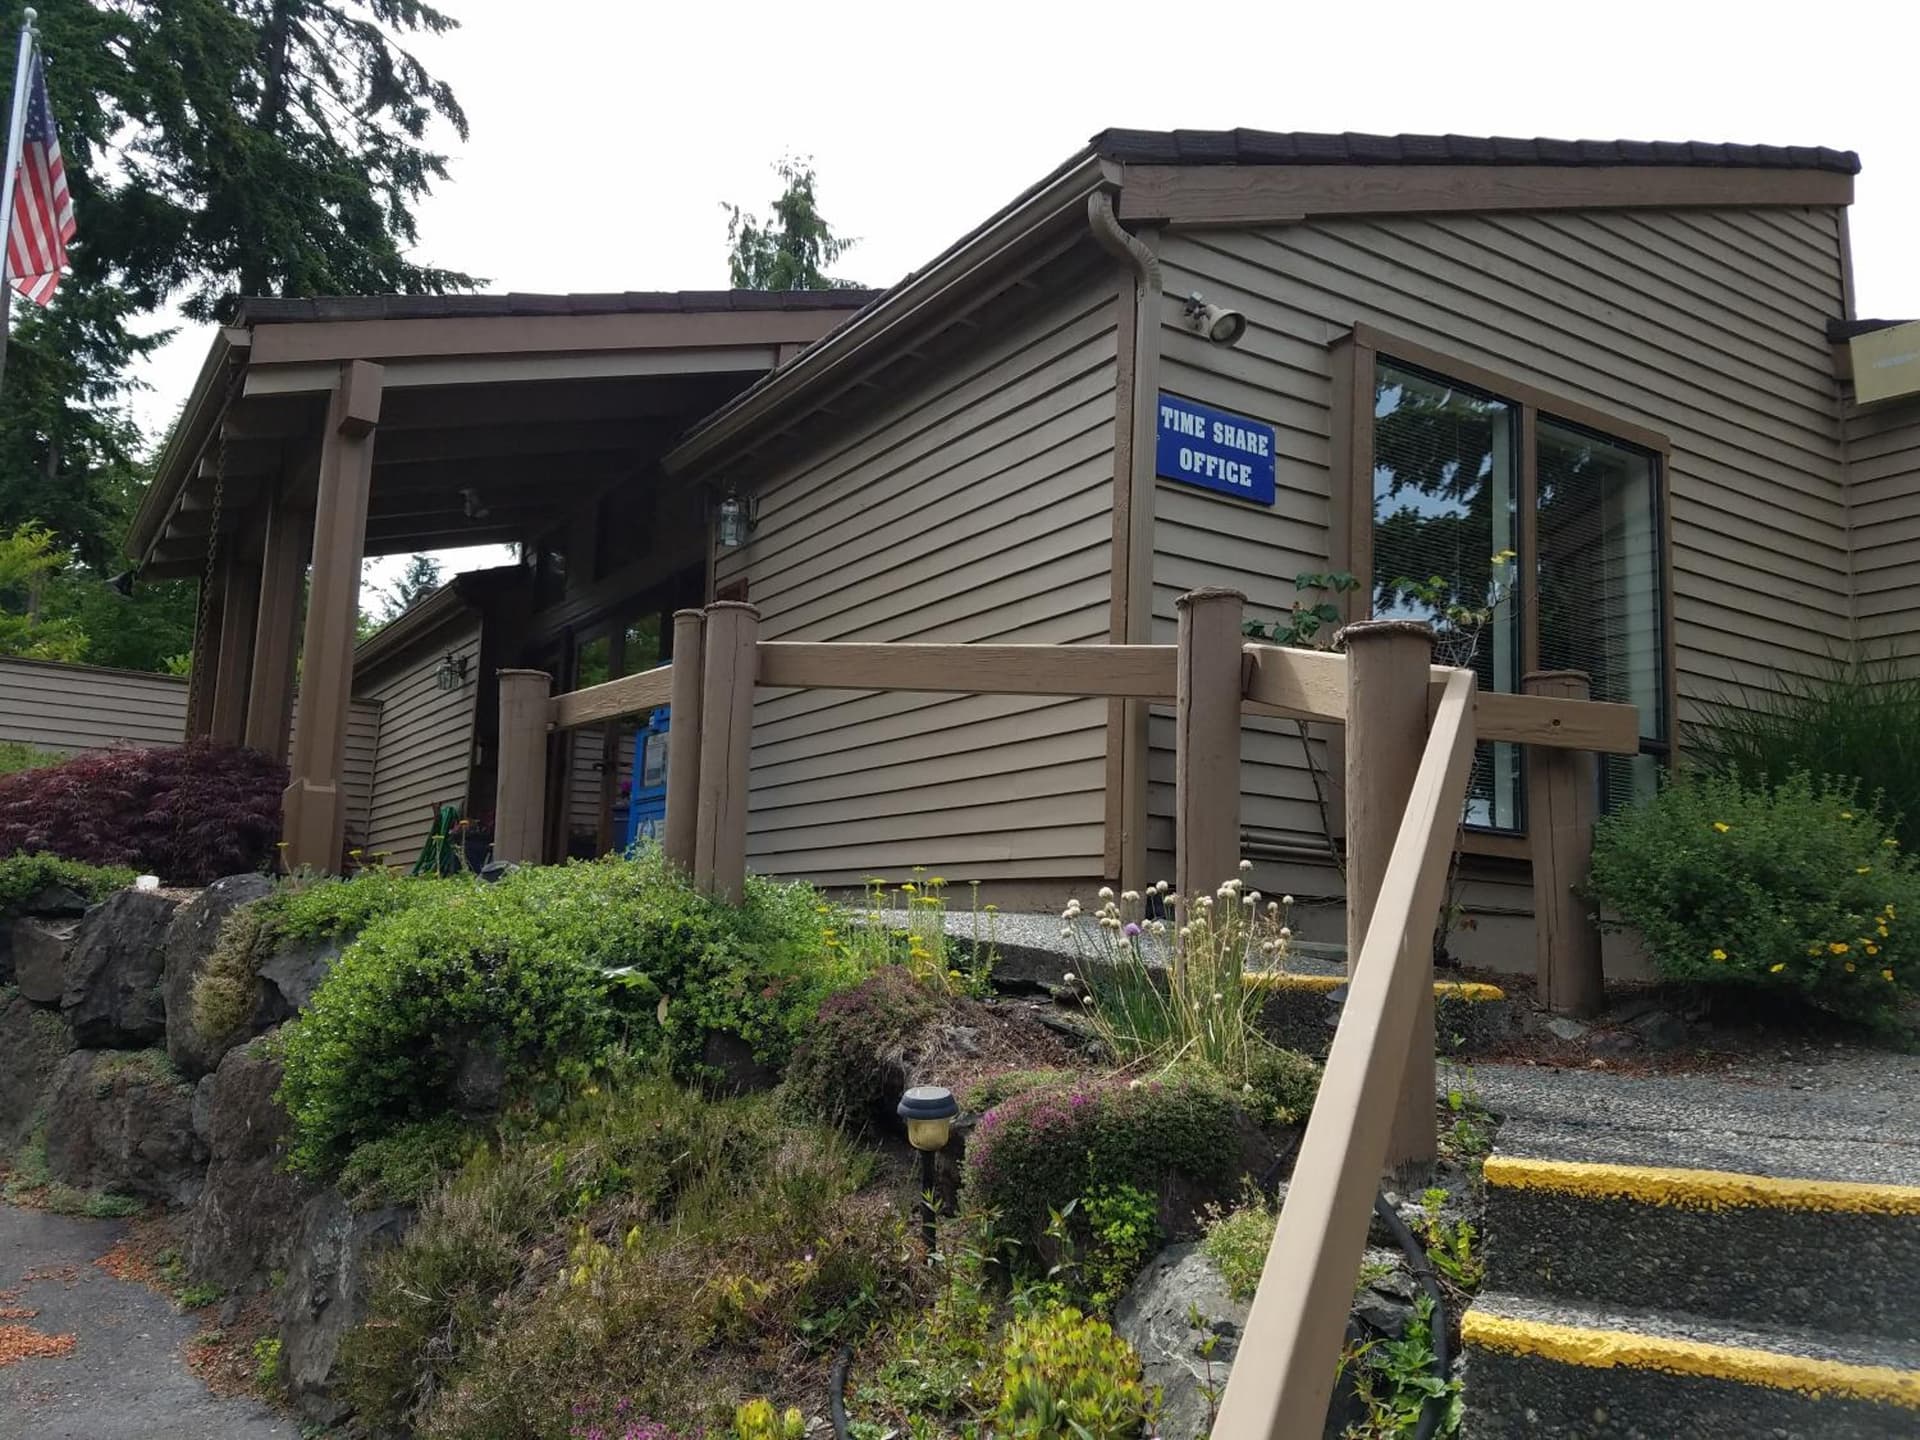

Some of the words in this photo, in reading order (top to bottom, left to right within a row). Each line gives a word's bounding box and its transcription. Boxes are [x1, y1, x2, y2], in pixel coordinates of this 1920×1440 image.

[1161, 405, 1205, 438] TIME
[1213, 422, 1268, 456] SHARE
[1180, 448, 1251, 487] OFFICE
